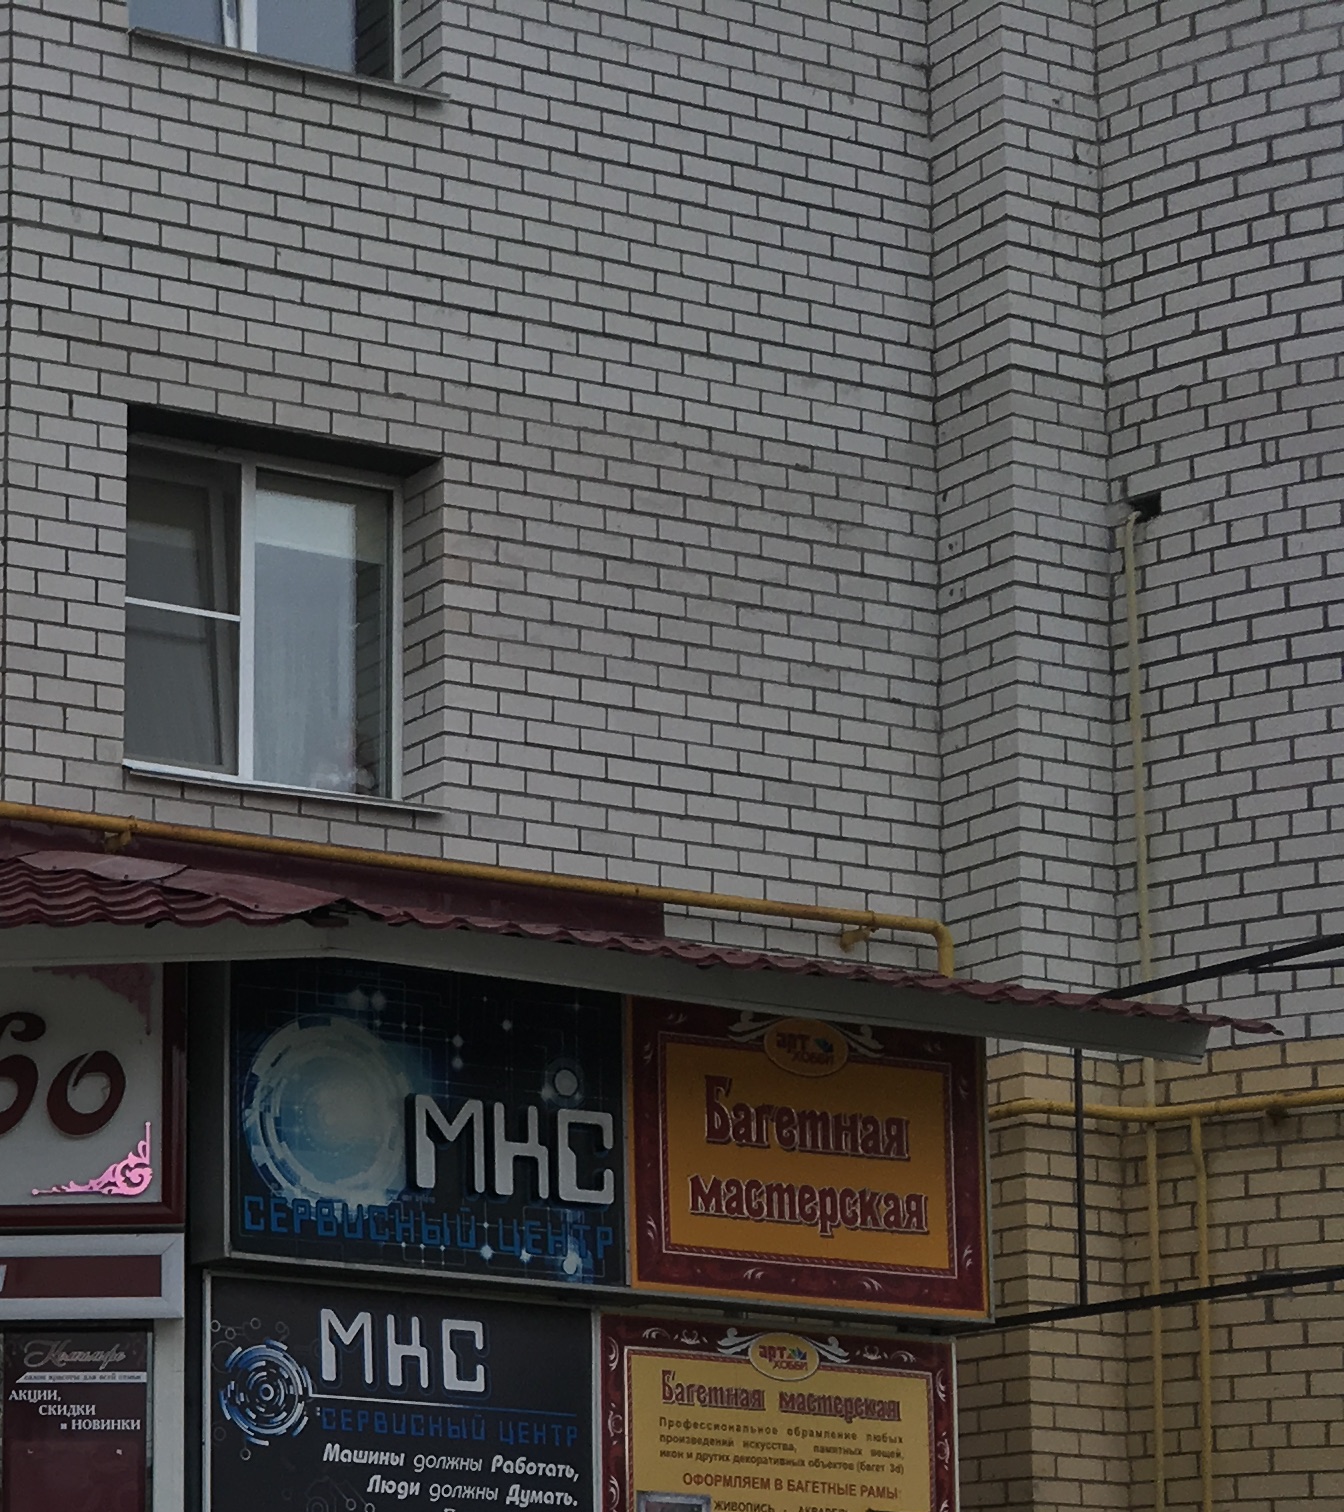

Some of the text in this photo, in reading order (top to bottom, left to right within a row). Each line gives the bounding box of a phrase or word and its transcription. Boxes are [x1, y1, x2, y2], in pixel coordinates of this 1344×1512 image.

[705, 1075, 910, 1162] Багетная
[690, 1172, 929, 1239] мастерская
[243, 1195, 614, 1263] СЕРВИСНЫЙ ЦЕНТР
[8, 1389, 62, 1403] АКЦИИ,
[38, 1404, 96, 1417] СКИДКИ
[661, 1370, 902, 1423] Багетная мастерская
[71, 1419, 141, 1430] НОВИНКИ
[321, 1407, 579, 1447] СЕРВИСНЫЙ ЦЕНТР
[659, 1416, 904, 1444] Профессиональное обрамление любых
[659, 1434, 734, 1448] произведений
[323, 1443, 580, 1482] Машины должны Работать,
[660, 1450, 684, 1459] икон
[695, 1451, 730, 1464] других
[732, 1454, 805, 1468] декоративных
[808, 1459, 854, 1472] объектов
[366, 1474, 579, 1508] Люди должны Думать.
[683, 1472, 770, 1491] ОФОРМЛЯЕМ
[775, 1478, 783, 1490] В
[787, 1479, 856, 1496] БАГЕТНЫЕ
